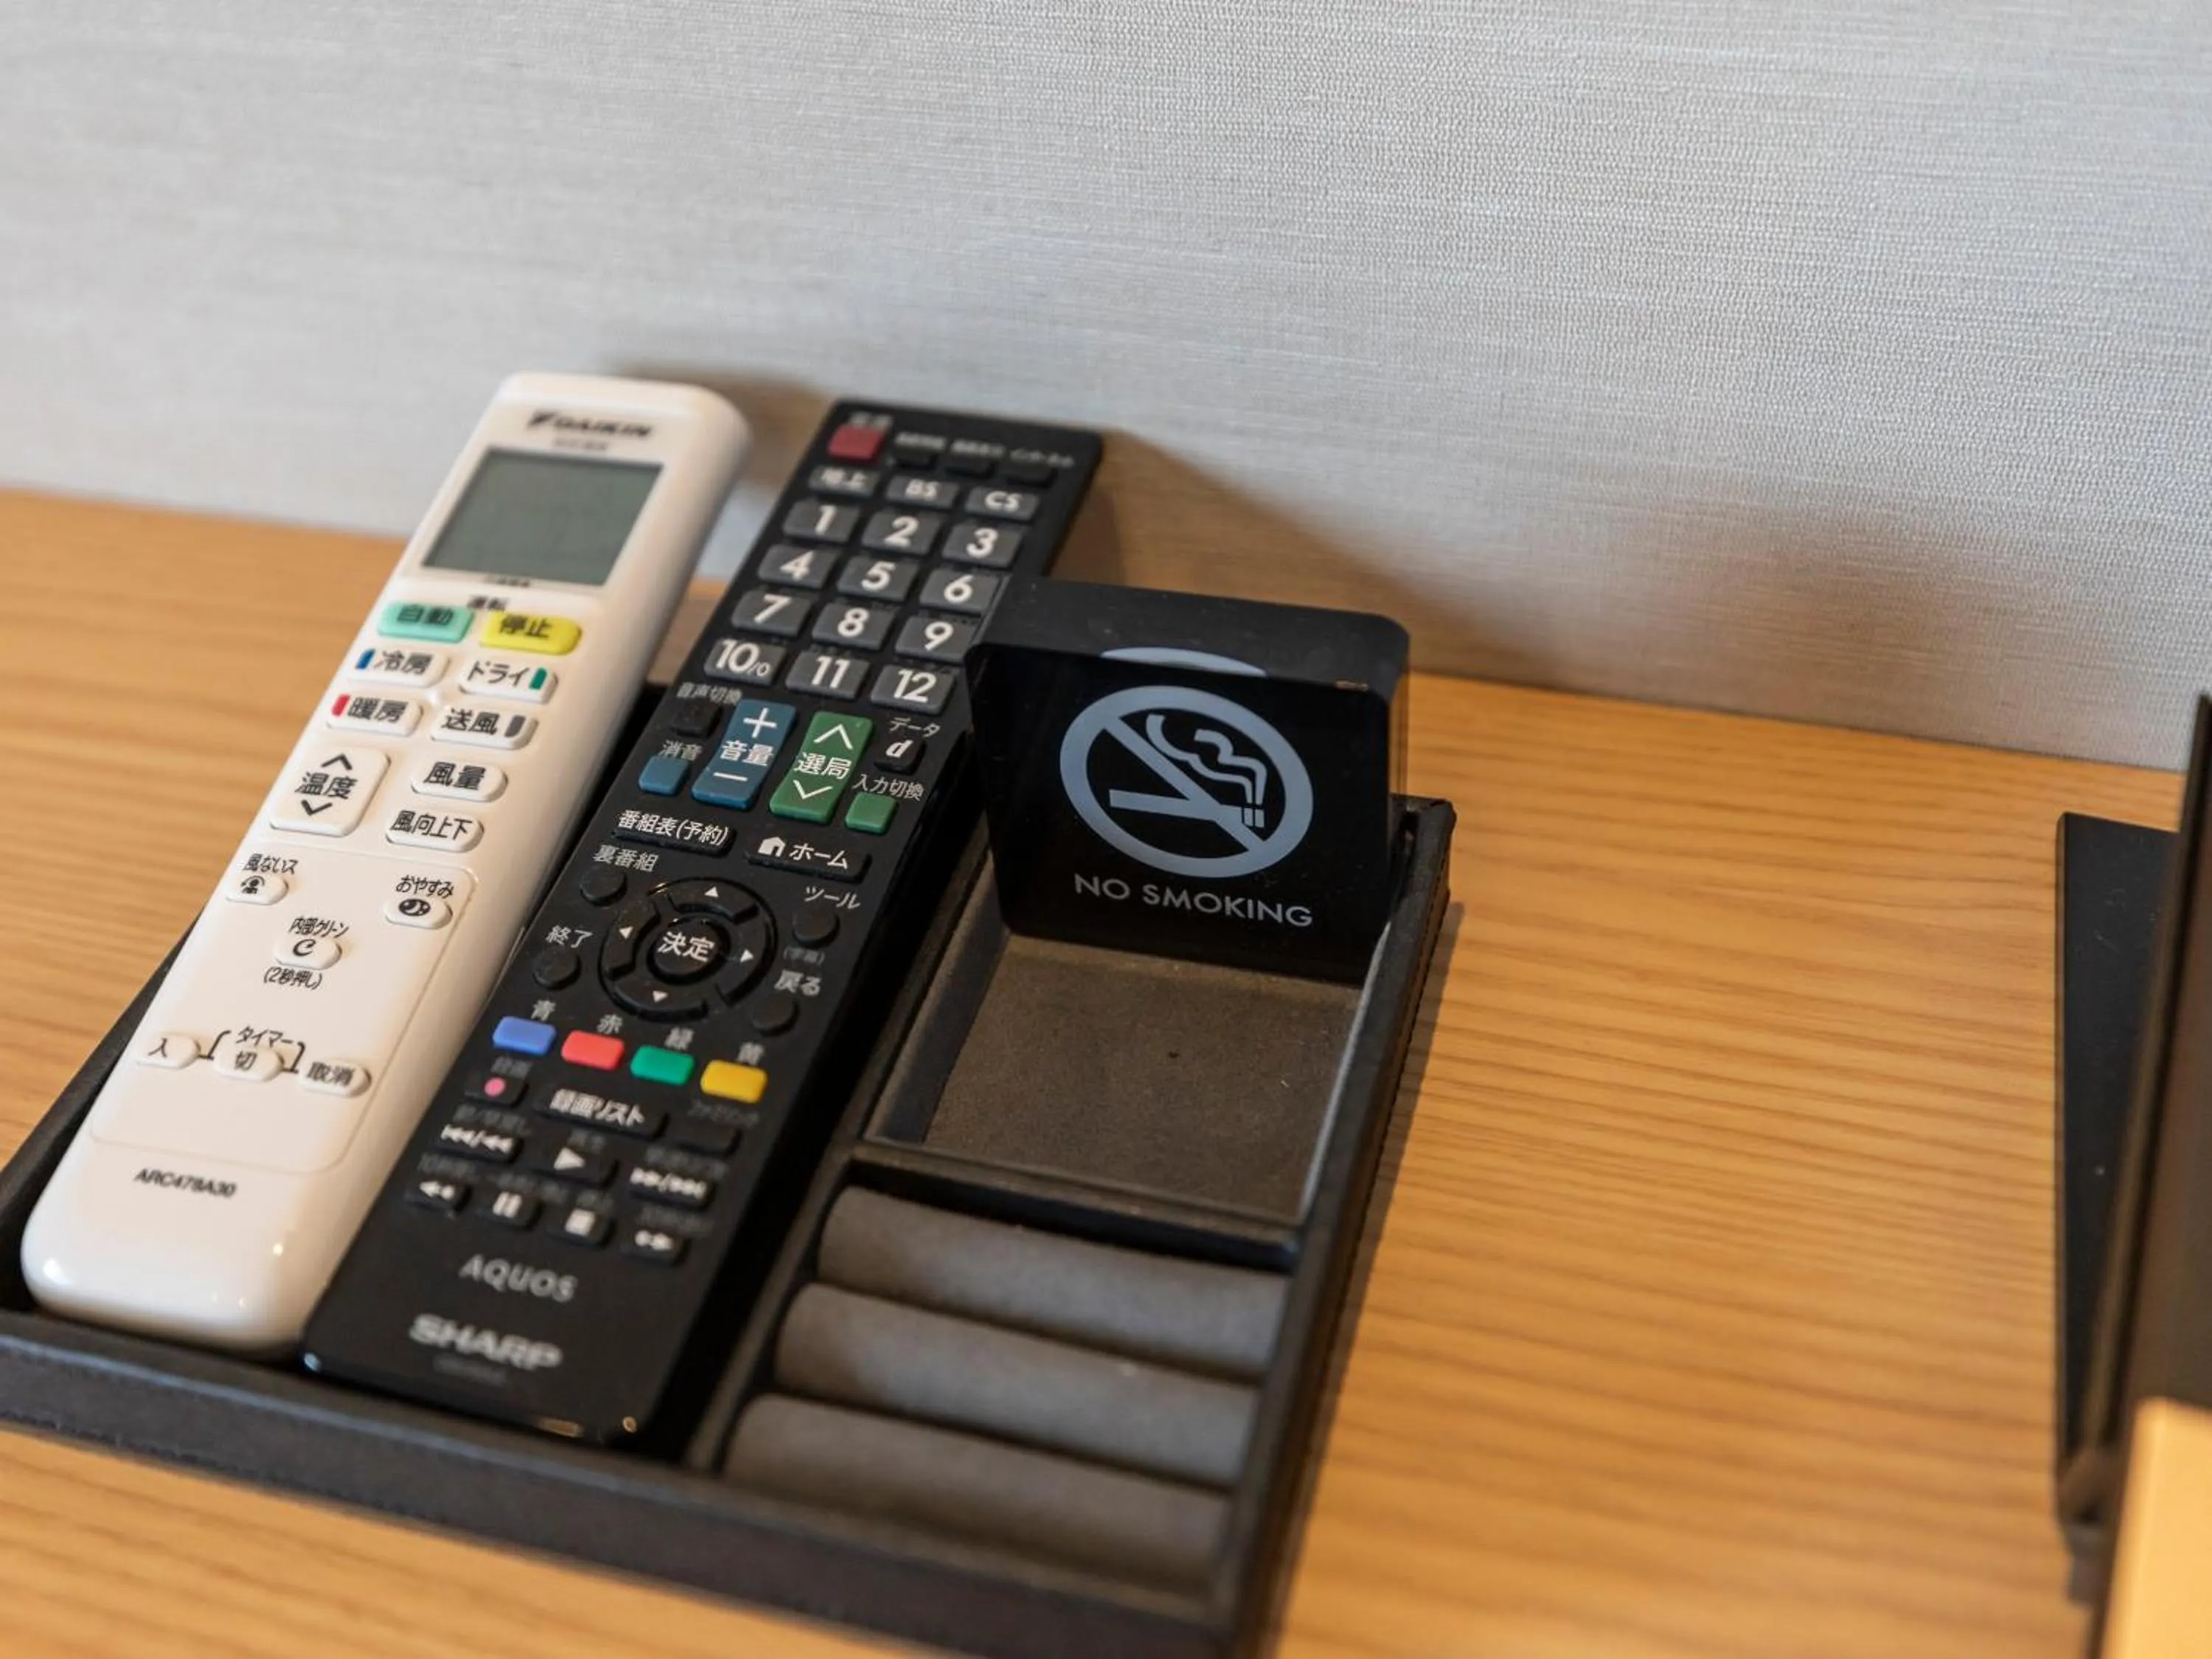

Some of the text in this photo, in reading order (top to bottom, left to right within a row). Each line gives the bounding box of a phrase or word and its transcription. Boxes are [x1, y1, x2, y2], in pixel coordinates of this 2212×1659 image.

[904, 479, 939, 502] BS
[984, 490, 1023, 513] CS
[815, 504, 837, 535] 1
[884, 516, 919, 548] 2
[966, 527, 999, 559] 3
[780, 550, 813, 581] 4
[860, 561, 896, 591] 5
[943, 573, 974, 604] 6
[396, 604, 455, 627] 自動
[754, 594, 792, 624] 7
[837, 607, 869, 639] 8
[498, 615, 554, 640] 停止
[925, 621, 954, 652] 9
[373, 650, 436, 675] 冷房
[467, 660, 530, 687] ドライ
[812, 655, 851, 689] 11
[893, 669, 937, 703] 12
[347, 697, 409, 723] 暖房
[441, 707, 500, 736] 送風
[889, 716, 941, 738] データ
[658, 740, 703, 762] 消音
[719, 740, 774, 768] 音量
[793, 751, 853, 780] 選局
[295, 771, 358, 801] 温度
[422, 761, 487, 792] 風量
[852, 773, 926, 802] 入力切換
[389, 810, 473, 841] 風向上下
[617, 808, 731, 847] 番組表(予約)
[592, 844, 661, 873] 裏番組
[789, 843, 849, 870] ホーム
[395, 874, 455, 898] おやすみ
[803, 885, 863, 911] ツール
[1074, 872, 1314, 928] NO SMOKING
[544, 924, 593, 949] 終了
[657, 931, 715, 963] 決定
[774, 969, 821, 996] 戻る
[147, 1037, 170, 1059] 入
[235, 1024, 294, 1046] タイマー
[234, 1049, 259, 1072] 切
[306, 1060, 356, 1088] 取消
[458, 1253, 579, 1304] AQUOS
[408, 1312, 564, 1371] SHARP
